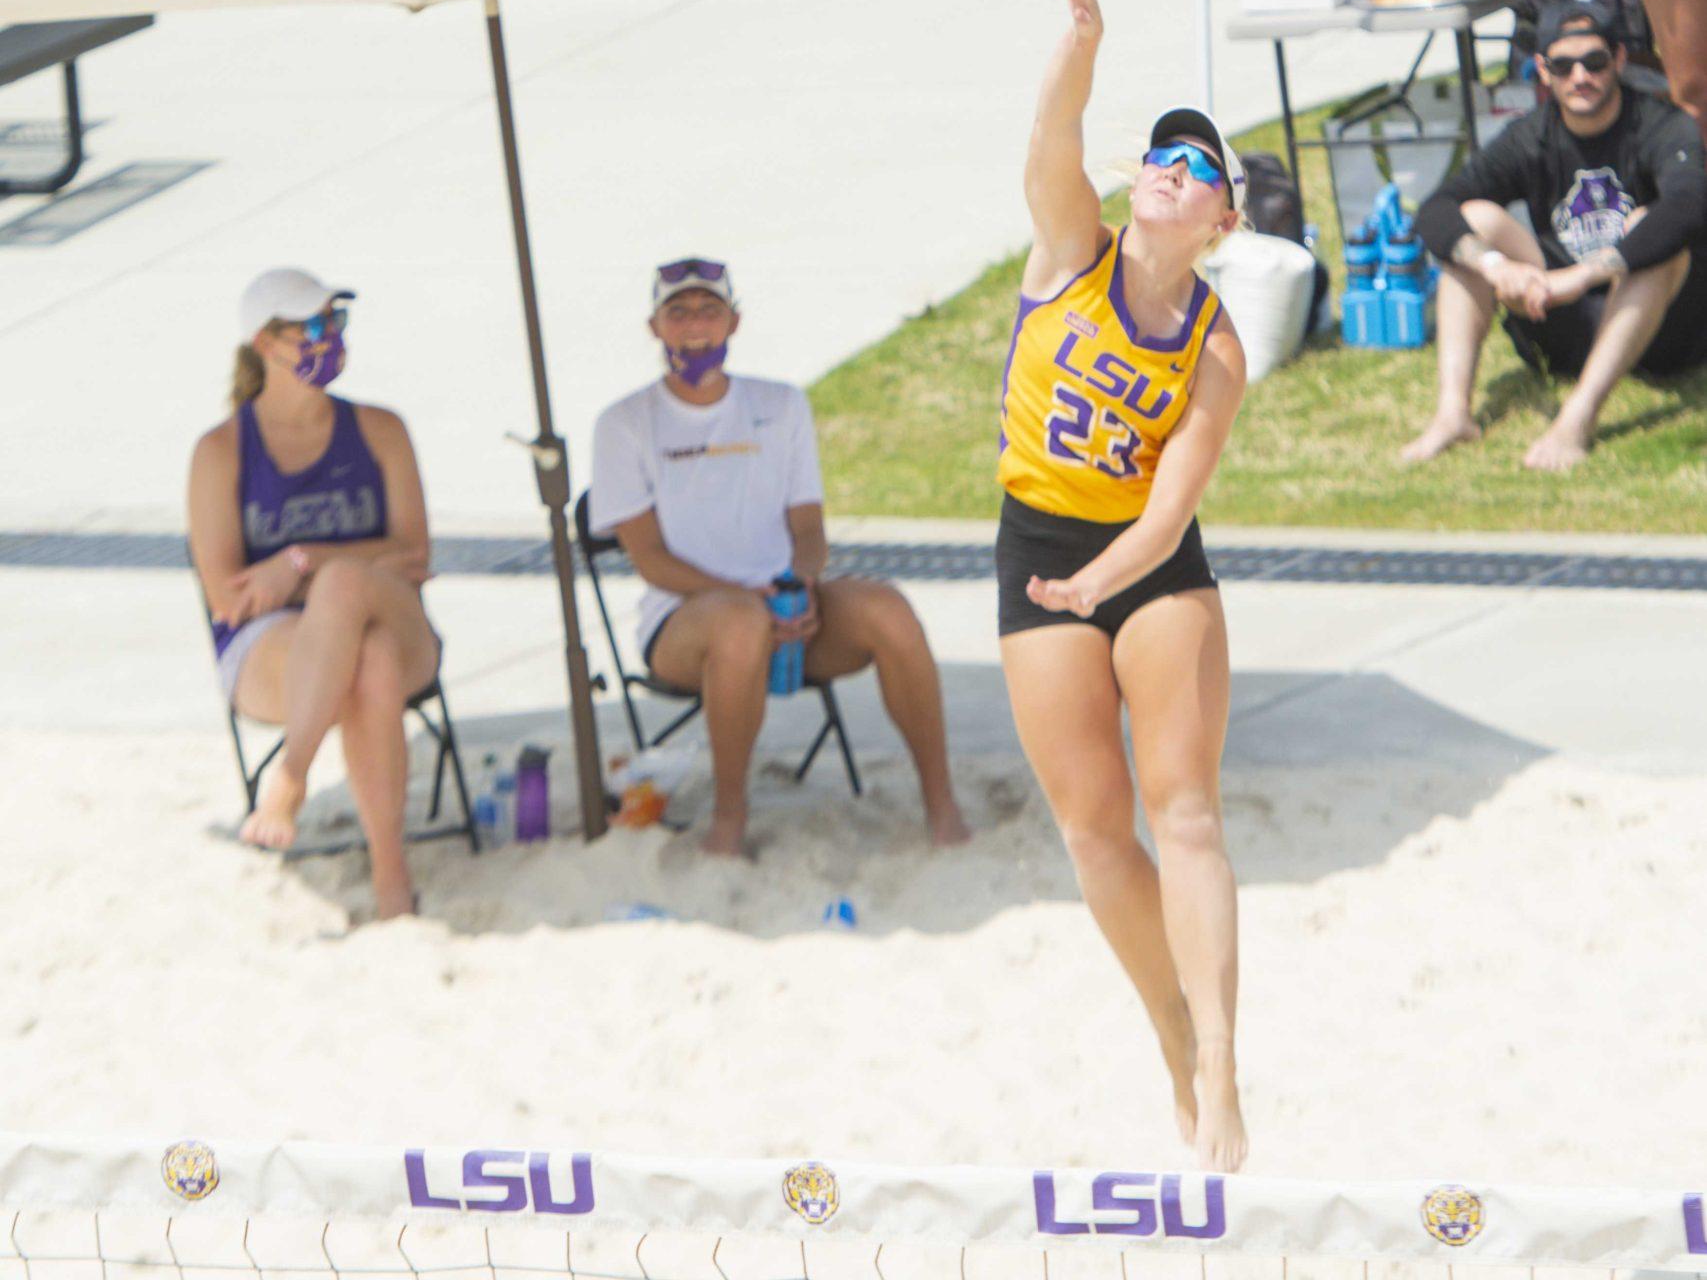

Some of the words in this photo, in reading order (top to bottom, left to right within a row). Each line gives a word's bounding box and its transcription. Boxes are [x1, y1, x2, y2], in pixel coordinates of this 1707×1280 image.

[1053, 331, 1173, 419] LSU
[1046, 384, 1143, 480] 23
[404, 1148, 595, 1215] LSU
[1033, 1170, 1226, 1239] LSU
